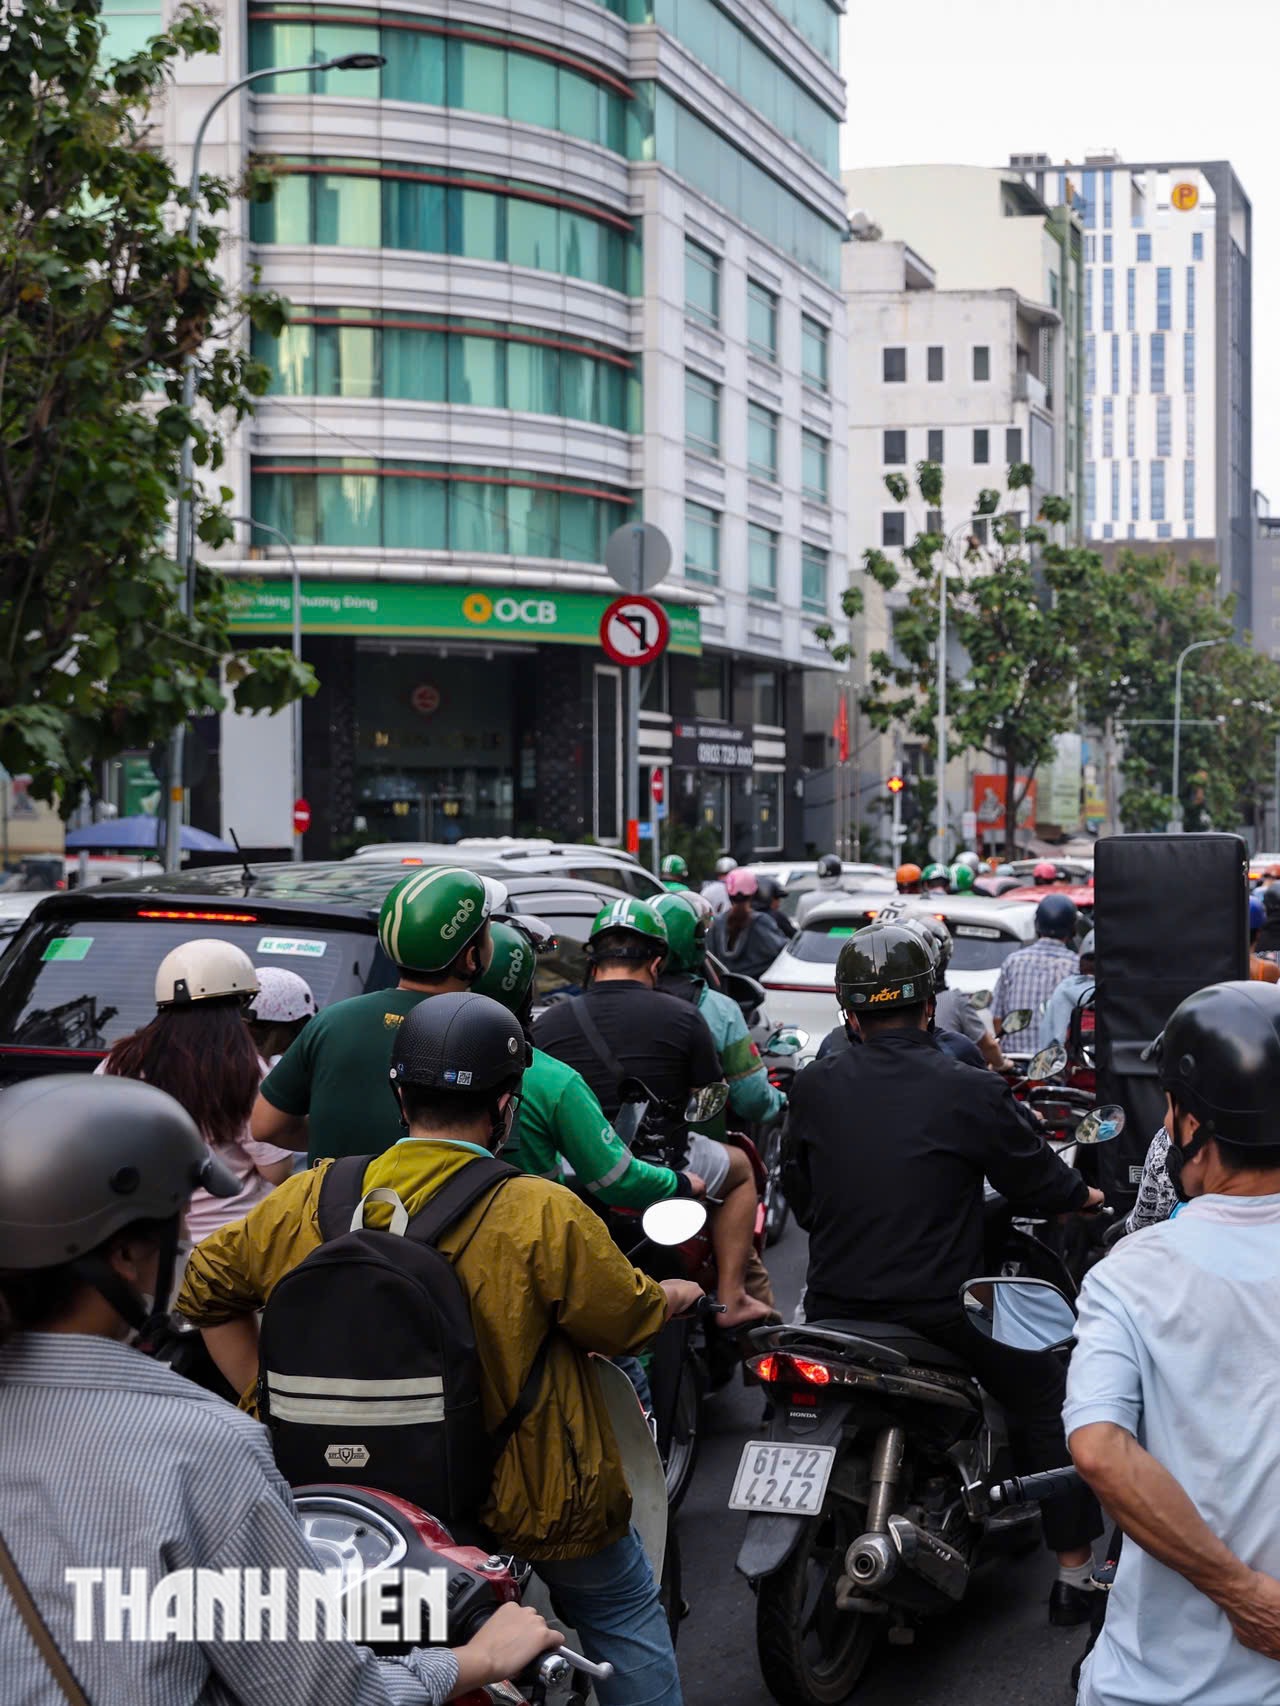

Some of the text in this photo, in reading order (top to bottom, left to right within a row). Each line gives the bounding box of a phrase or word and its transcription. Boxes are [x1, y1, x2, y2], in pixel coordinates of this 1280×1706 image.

[494, 597, 557, 624] OCB
[439, 898, 476, 940] Grab
[502, 948, 524, 991] Grab
[789, 1411, 818, 1419] HONDA
[745, 1478, 813, 1509] 4242
